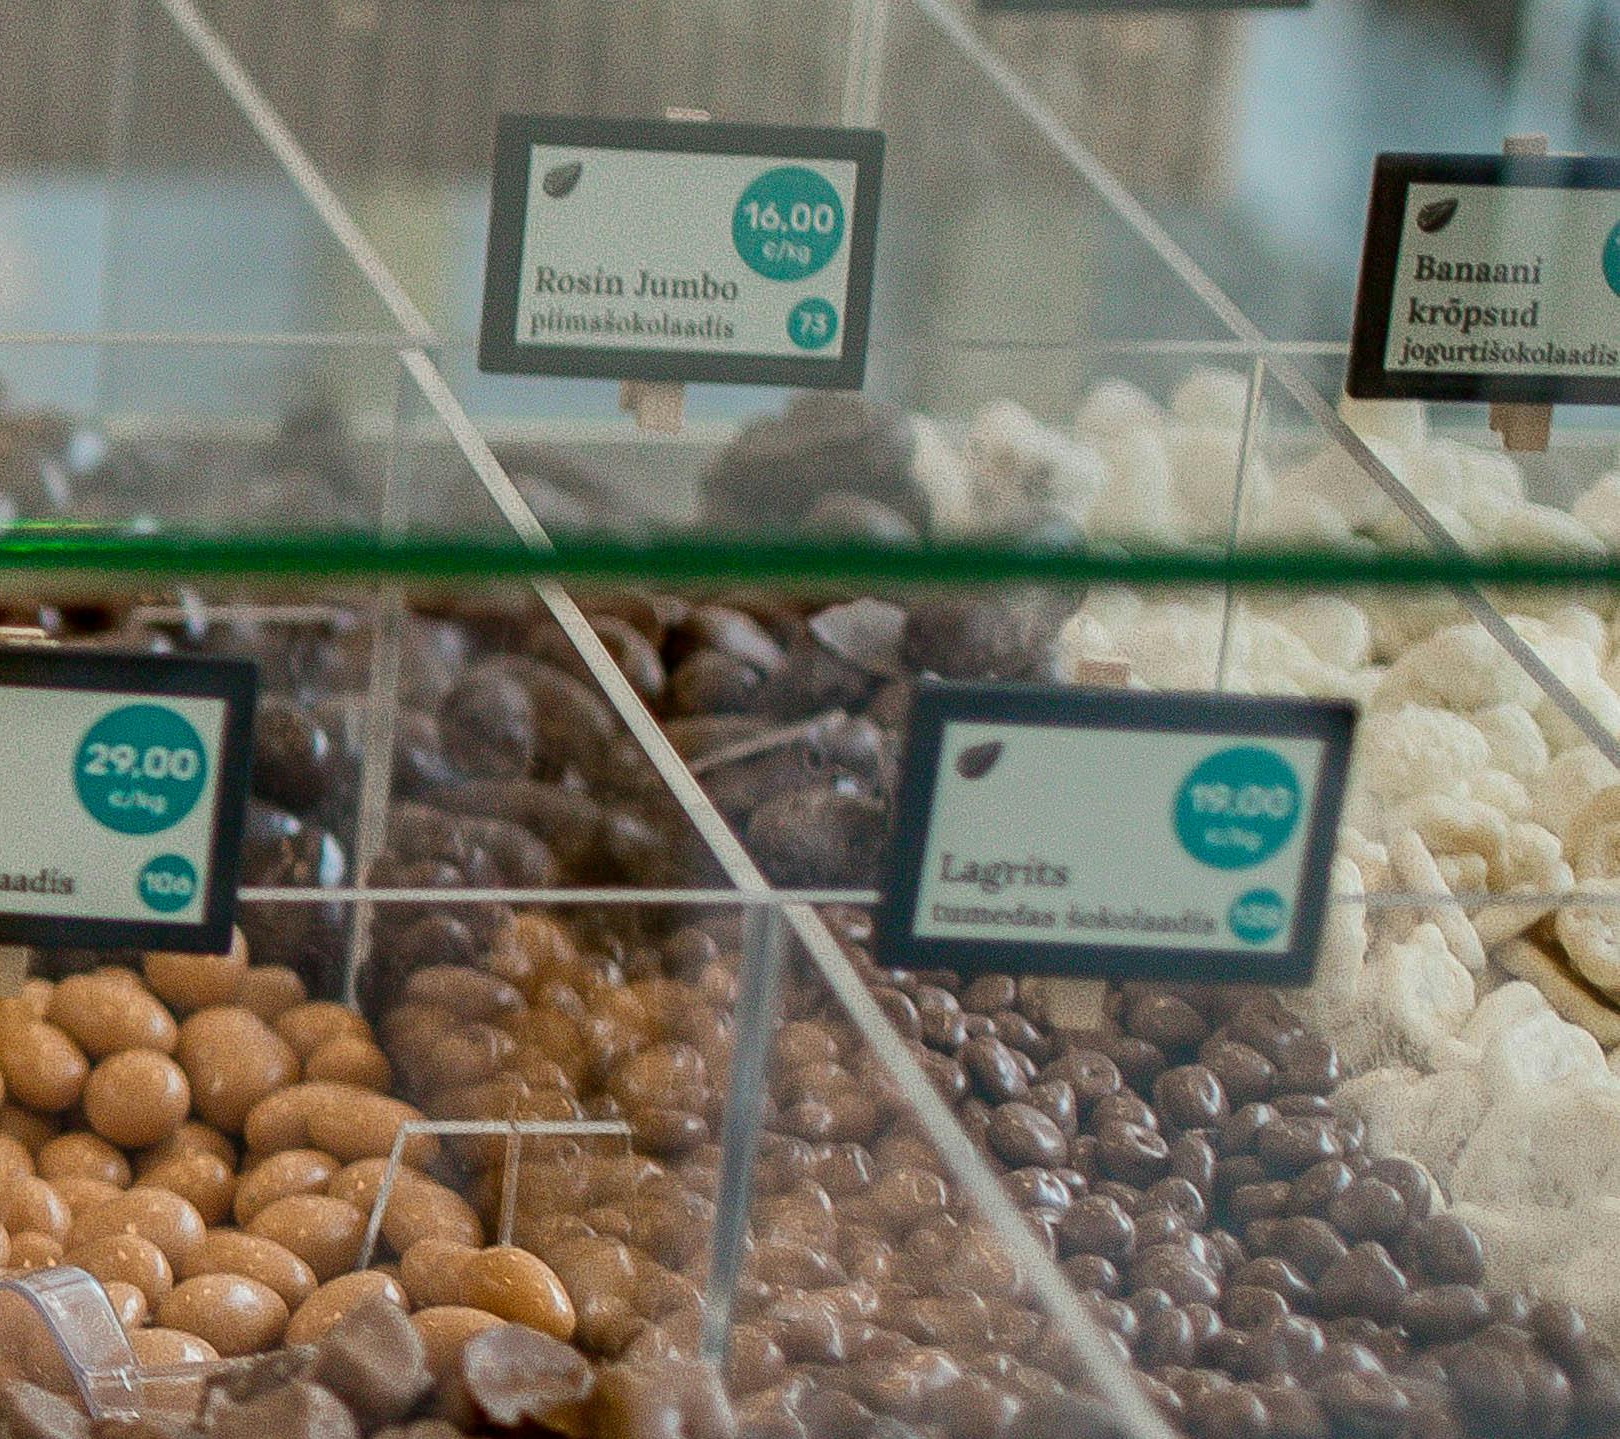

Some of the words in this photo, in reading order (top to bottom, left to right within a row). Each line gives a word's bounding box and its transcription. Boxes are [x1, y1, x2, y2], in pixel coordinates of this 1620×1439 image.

[742, 202, 836, 234] 16.00
[535, 264, 624, 297] Rosin
[634, 268, 740, 301] Jumbo
[1414, 255, 1543, 285] Banaani
[531, 310, 736, 340] piimašokolaadis
[1408, 295, 1540, 334] krõpsud
[1397, 337, 1620, 367] jogurtišokolaadis
[84, 742, 202, 782] 29.00
[939, 854, 1070, 895] Lagrits
